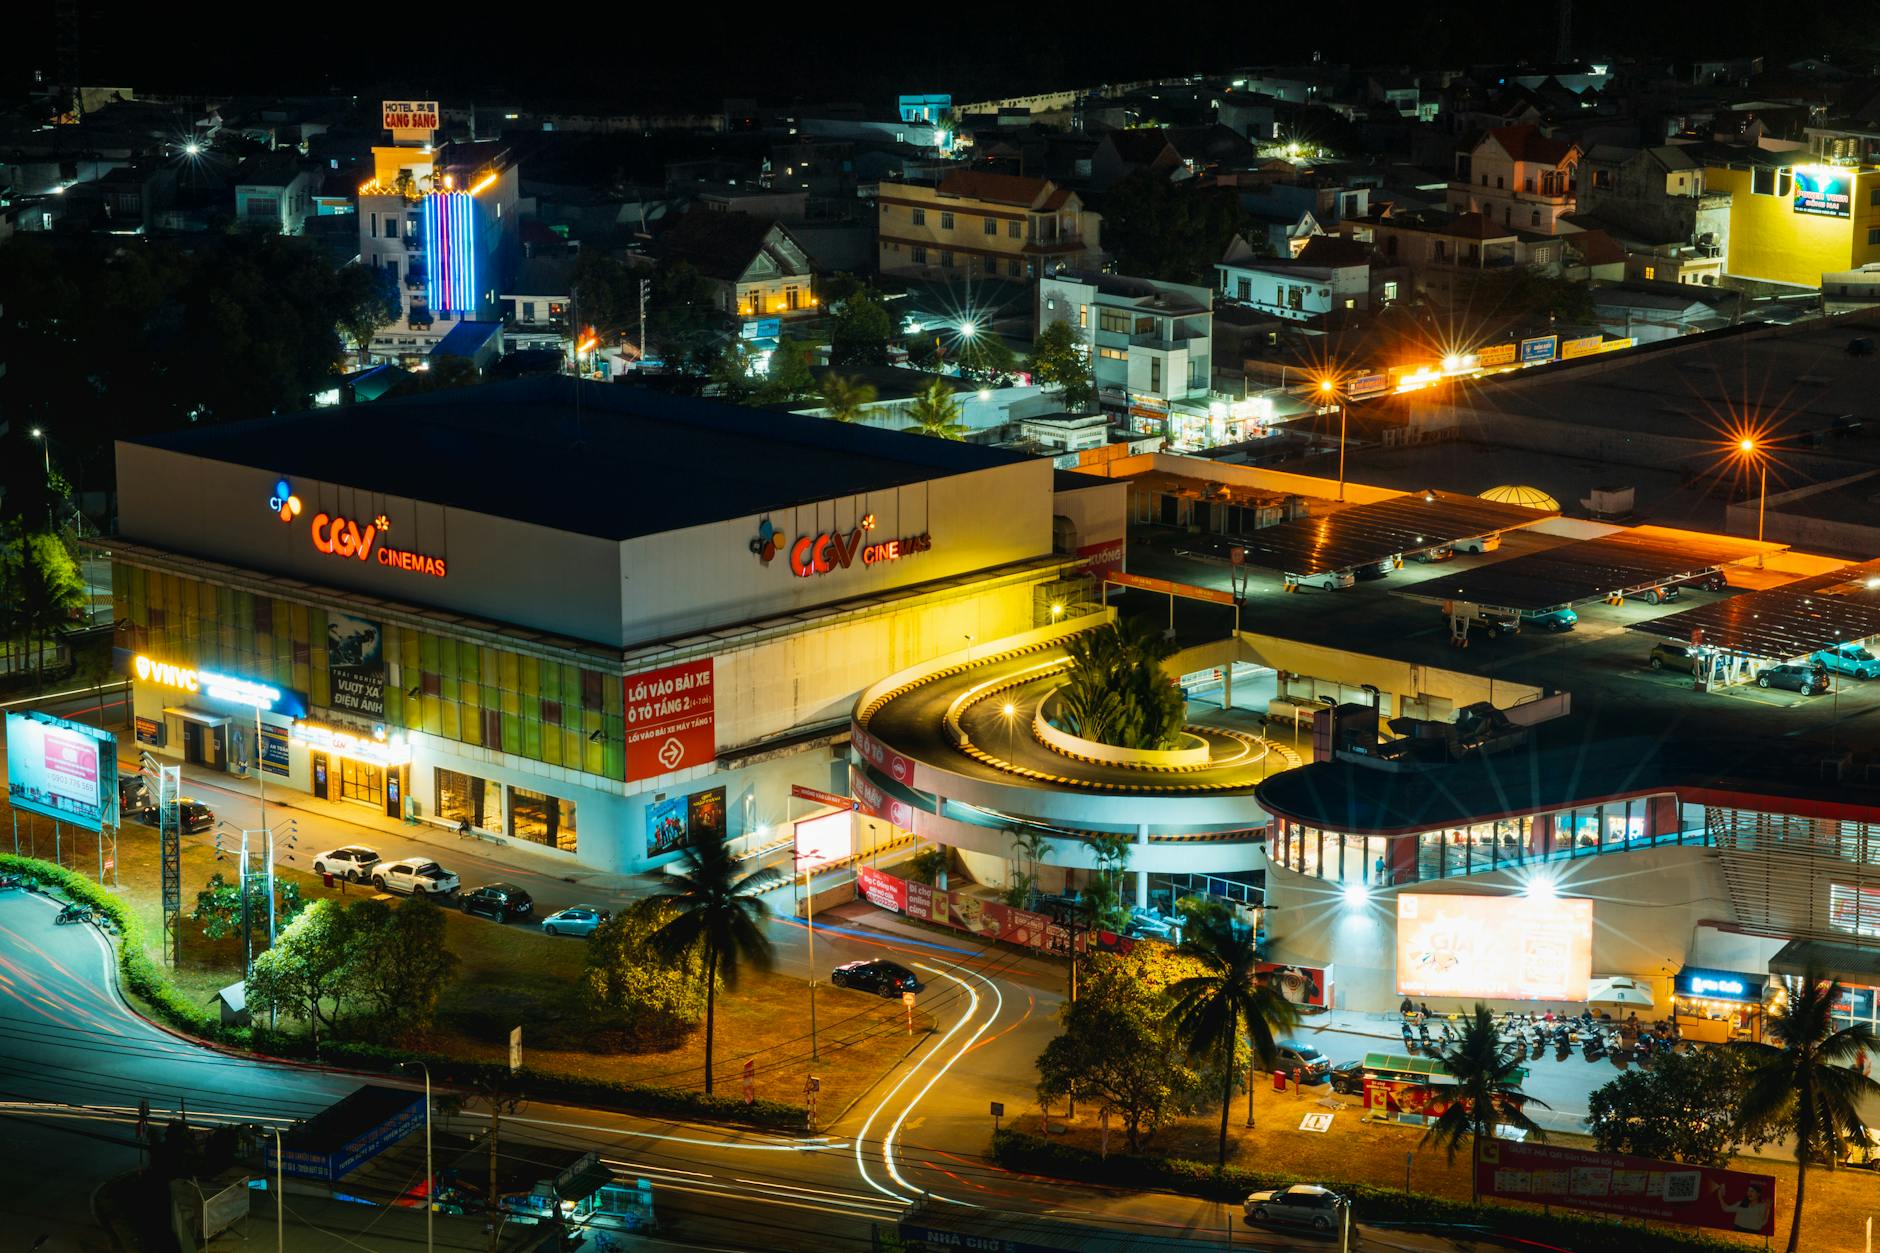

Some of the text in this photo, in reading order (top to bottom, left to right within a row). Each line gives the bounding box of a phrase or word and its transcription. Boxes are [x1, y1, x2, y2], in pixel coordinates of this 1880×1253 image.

[385, 103, 413, 112] HOTEL
[412, 113, 437, 128] SANG
[270, 496, 283, 512] CJ
[311, 513, 446, 577] CGV CINEMAS
[791, 527, 932, 577] CGV CINEMAS
[628, 671, 710, 702] LỐI VÀO BÃI XE
[335, 692, 359, 709] ĐIỆN
[628, 706, 637, 723] Ô
[638, 702, 653, 721] TÔ
[653, 696, 682, 717] TẦNG
[683, 696, 690, 710] 2
[628, 730, 640, 743] LỐI
[640, 729, 655, 740] VÀO
[655, 727, 667, 737] BÃI
[667, 725, 676, 733] XE
[676, 721, 691, 732] MÁY
